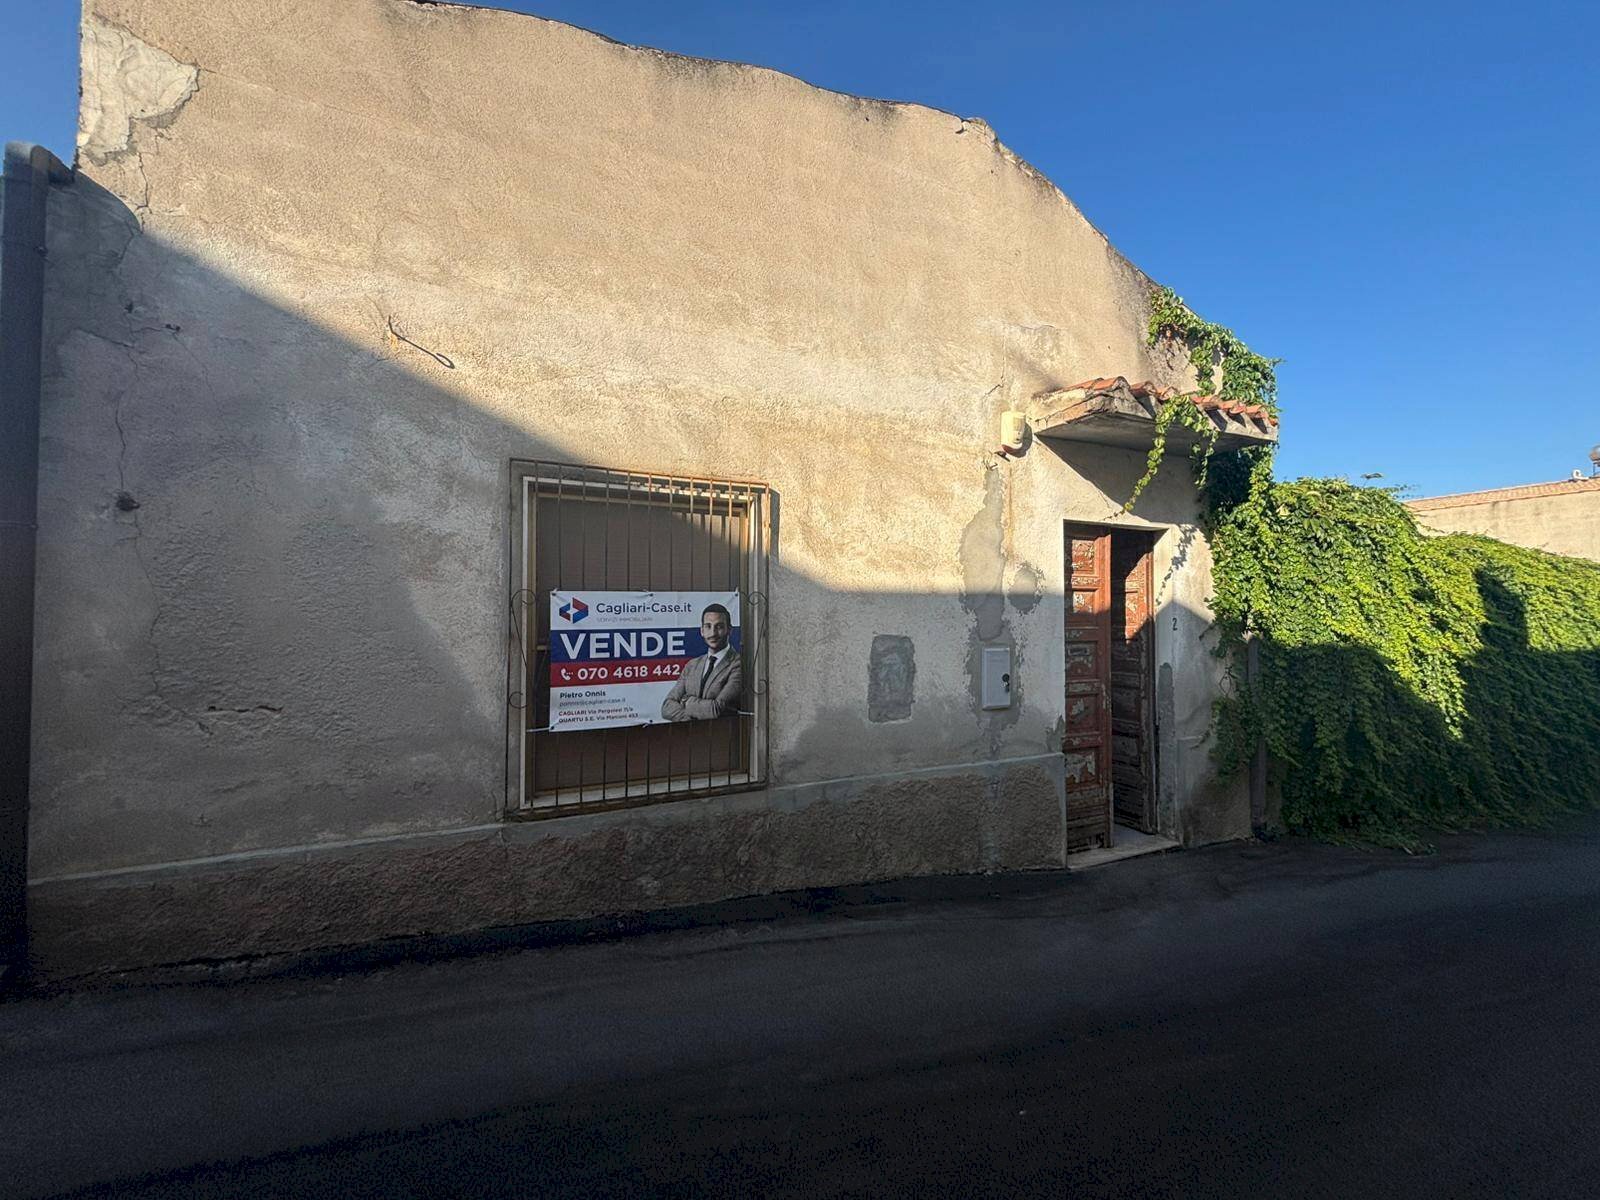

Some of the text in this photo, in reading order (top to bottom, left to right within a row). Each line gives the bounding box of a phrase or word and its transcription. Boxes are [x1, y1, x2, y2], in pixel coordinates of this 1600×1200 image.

[596, 602, 692, 615] Cagliari-Case.it
[1172, 617, 1178, 631] 2
[560, 631, 686, 660] VENDE
[577, 664, 680, 680] 070 4618 442
[585, 690, 606, 698] Onnis
[558, 716, 583, 724] QUARTU
